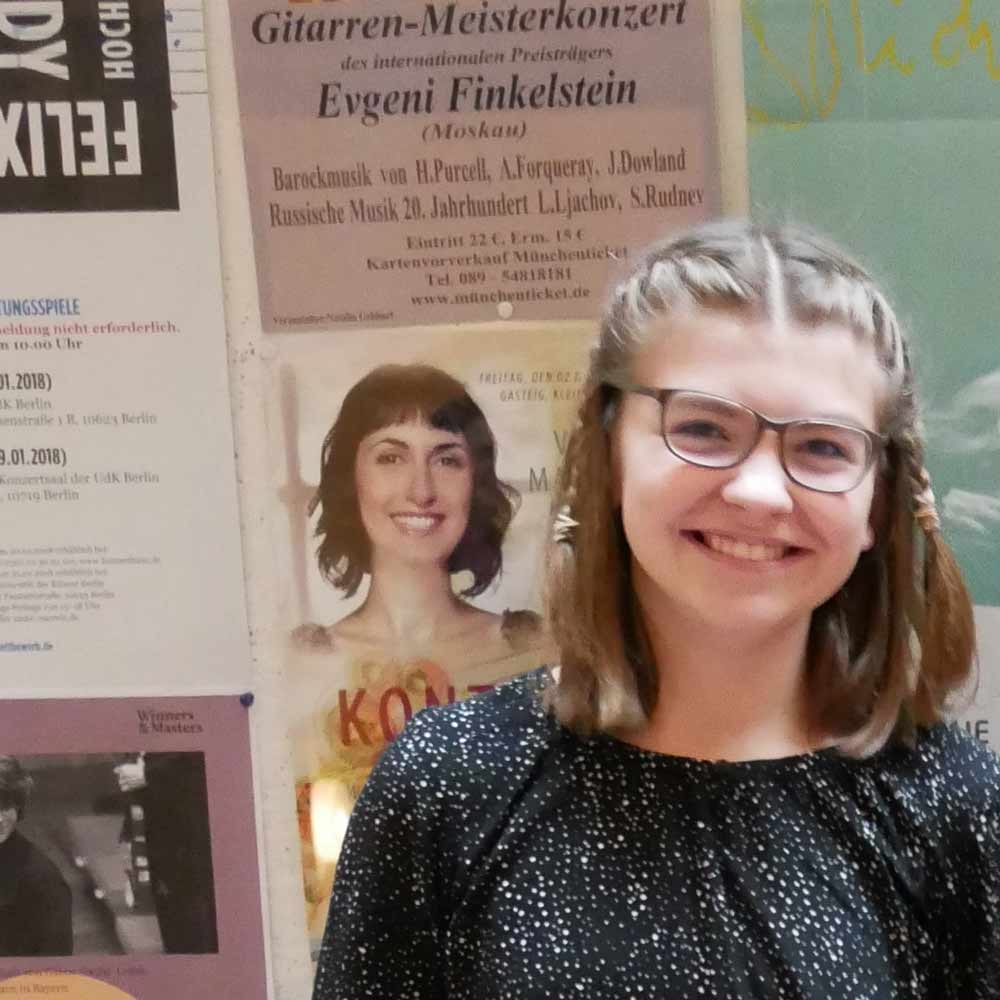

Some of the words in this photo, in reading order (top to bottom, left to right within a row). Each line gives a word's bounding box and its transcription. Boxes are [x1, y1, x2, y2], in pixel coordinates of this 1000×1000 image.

[251, 0, 687, 45] Gitarren-Meisterkonzert
[98, 0, 135, 79] HOCH
[340, 57, 367, 71] des
[373, 48, 505, 70] internationalen
[511, 44, 614, 66] Preisträgers
[317, 77, 434, 127] Evgeni
[448, 69, 638, 113] Finkelstein
[0, 99, 142, 177] FELIX
[421, 120, 528, 144] (Moskau)
[273, 163, 371, 193] Barockmusik
[380, 167, 406, 187] von
[607, 148, 686, 177] J.Dowland
[269, 199, 345, 227] Russische
[350, 197, 398, 224] Musik
[402, 197, 427, 221] 20.
[430, 191, 529, 220] Jahrhundert
[407, 231, 466, 251] Eintritt
[469, 231, 489, 247] 22
[366, 252, 511, 272] Kartenvorverkauf
[515, 244, 630, 265] Münchenticket
[53, 321, 88, 335] nicht
[92, 320, 181, 334] erforderlich.
[56, 337, 83, 349] Uhr
[16, 398, 52, 410] Berlin
[121, 414, 157, 426] Berlin
[71, 472, 90, 485] der
[124, 471, 160, 485] Berlin
[44, 489, 79, 501] Berlin
[138, 709, 195, 723] Winners
[152, 722, 204, 734] Masters
